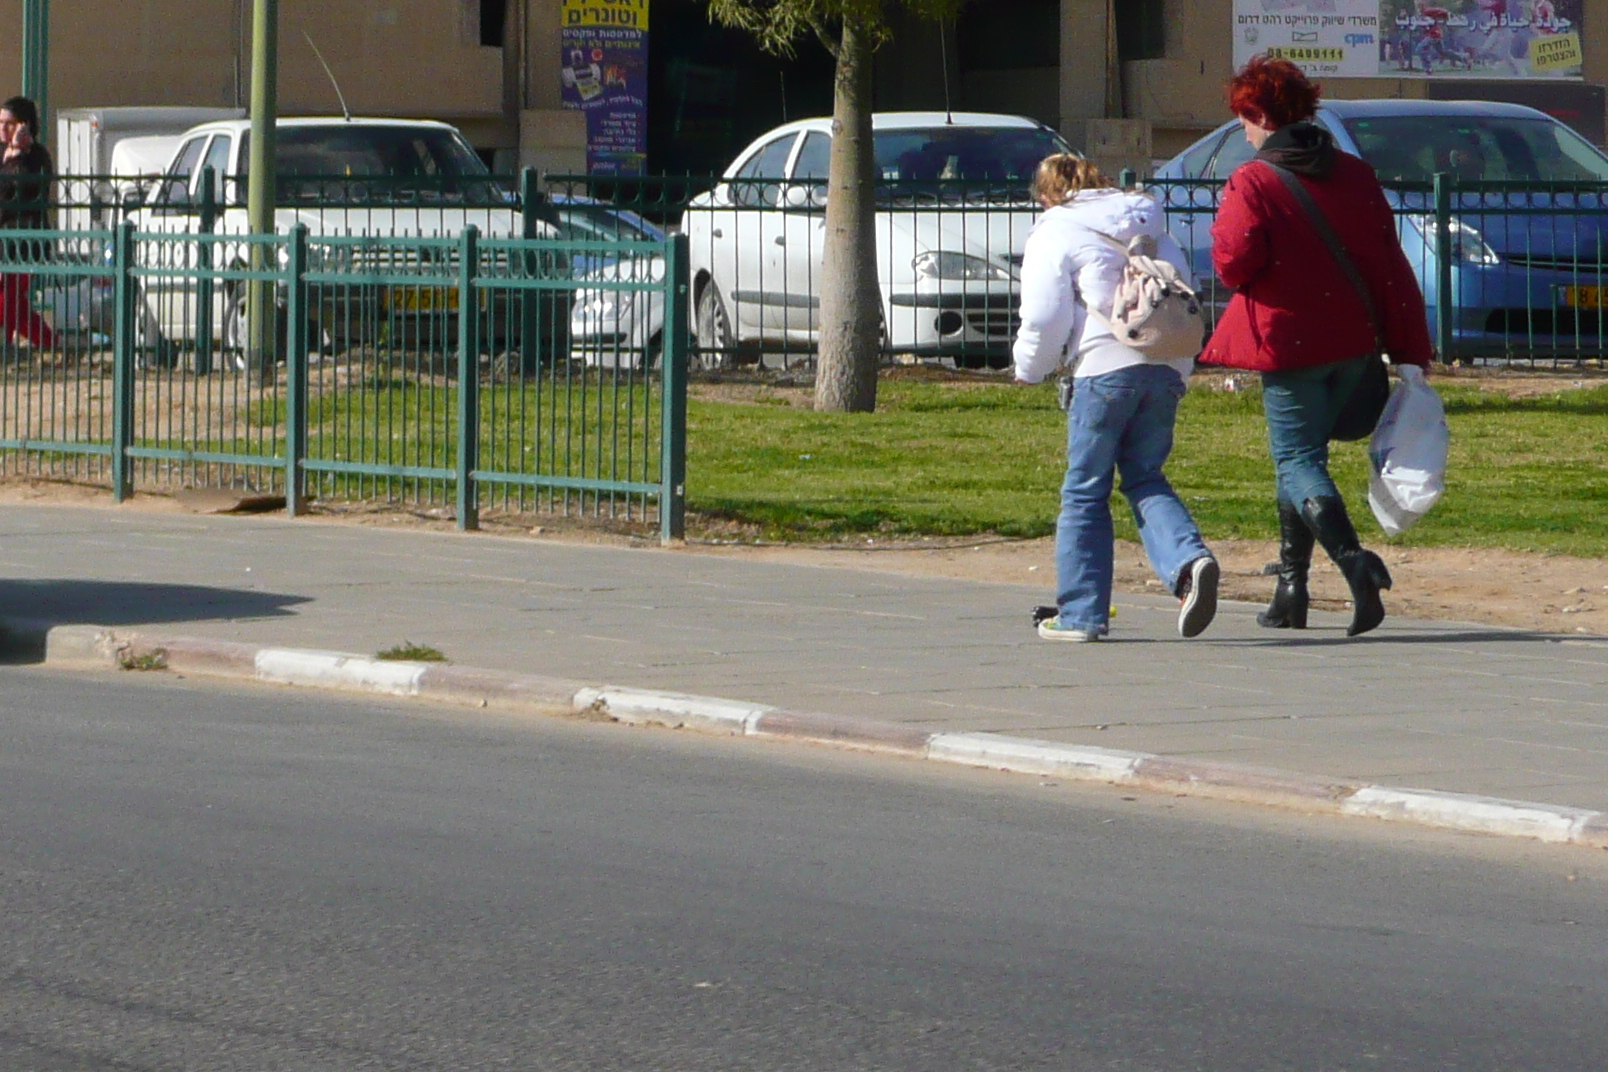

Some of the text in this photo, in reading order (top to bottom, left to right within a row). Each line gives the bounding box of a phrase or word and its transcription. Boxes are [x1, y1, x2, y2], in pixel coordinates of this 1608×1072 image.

[568, 7, 637, 26] וטונרים
[1238, 14, 1260, 25] דרום
[1262, 15, 1282, 25] רהט
[1348, 15, 1377, 26] משרדי
[1344, 32, 1375, 48] cpm
